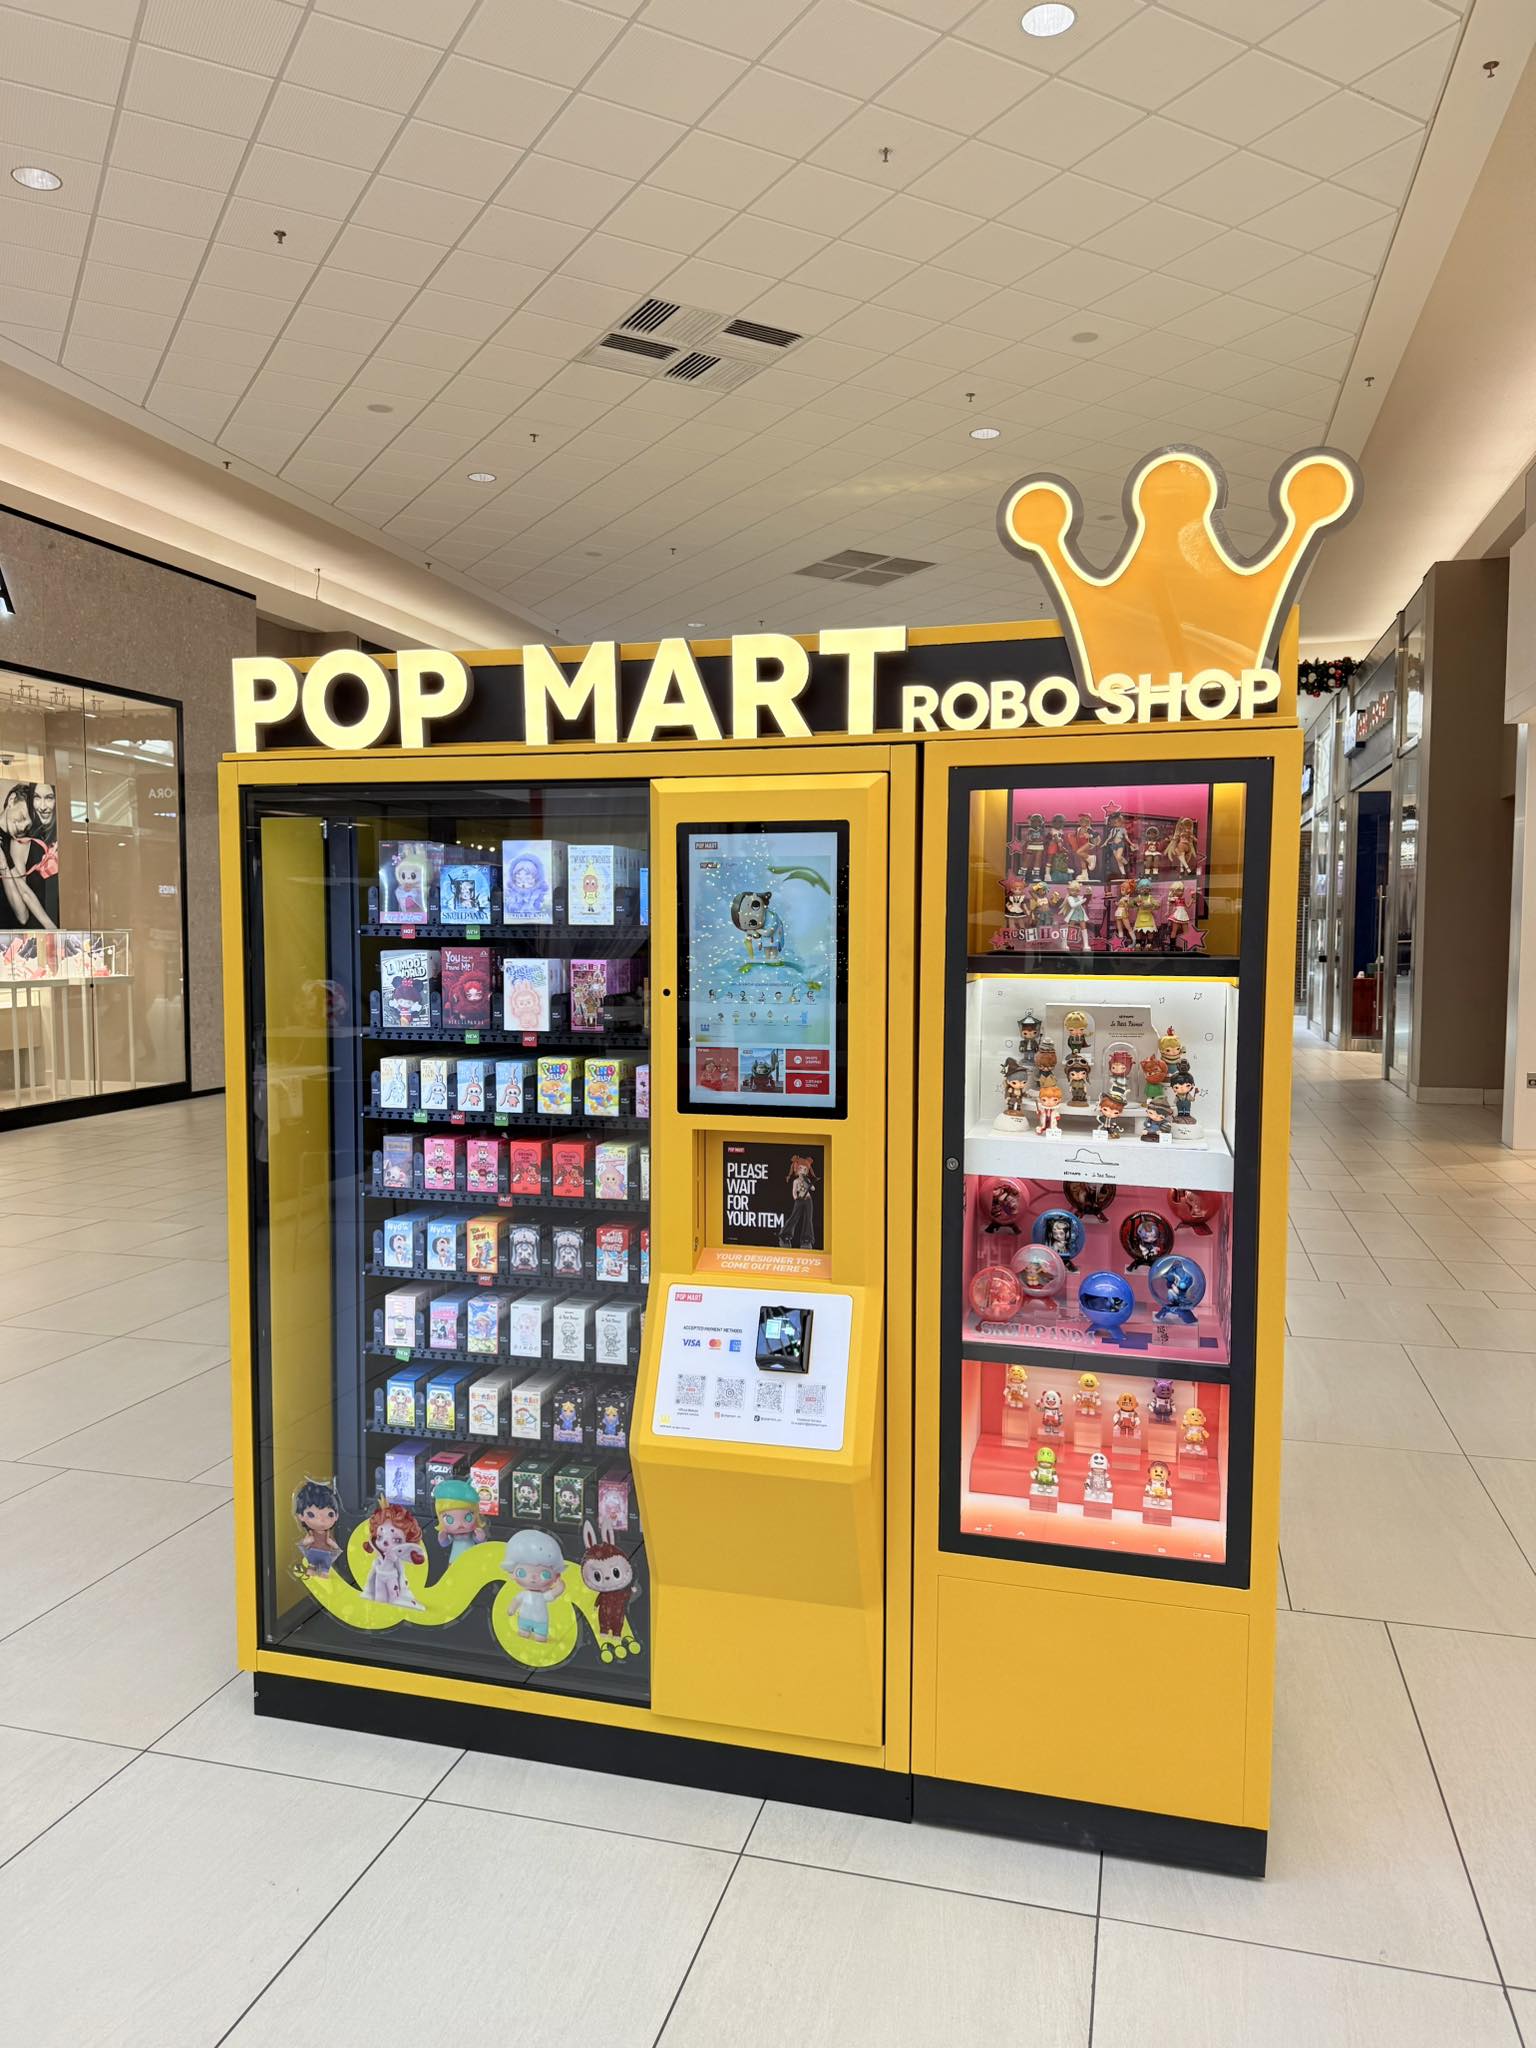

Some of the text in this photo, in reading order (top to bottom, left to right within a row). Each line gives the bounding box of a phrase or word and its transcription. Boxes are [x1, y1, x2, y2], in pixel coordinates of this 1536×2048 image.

[231, 625, 908, 753] POP MART
[902, 668, 1282, 733] ROBO SHOP
[727, 1162, 769, 1180] PLEASE
[726, 1178, 757, 1195] WAIT
[727, 1195, 749, 1211] FOR
[727, 1210, 785, 1228] YOUR ITEM
[716, 1252, 822, 1266] YOUR DESIGNER TOYS
[720, 1260, 801, 1273] COME OUT HERE
[675, 1293, 702, 1302] POP MART
[980, 1321, 1097, 1345] SKULLPANDA
[683, 1338, 701, 1347] VISA
[428, 1465, 452, 1474] MOLLY
